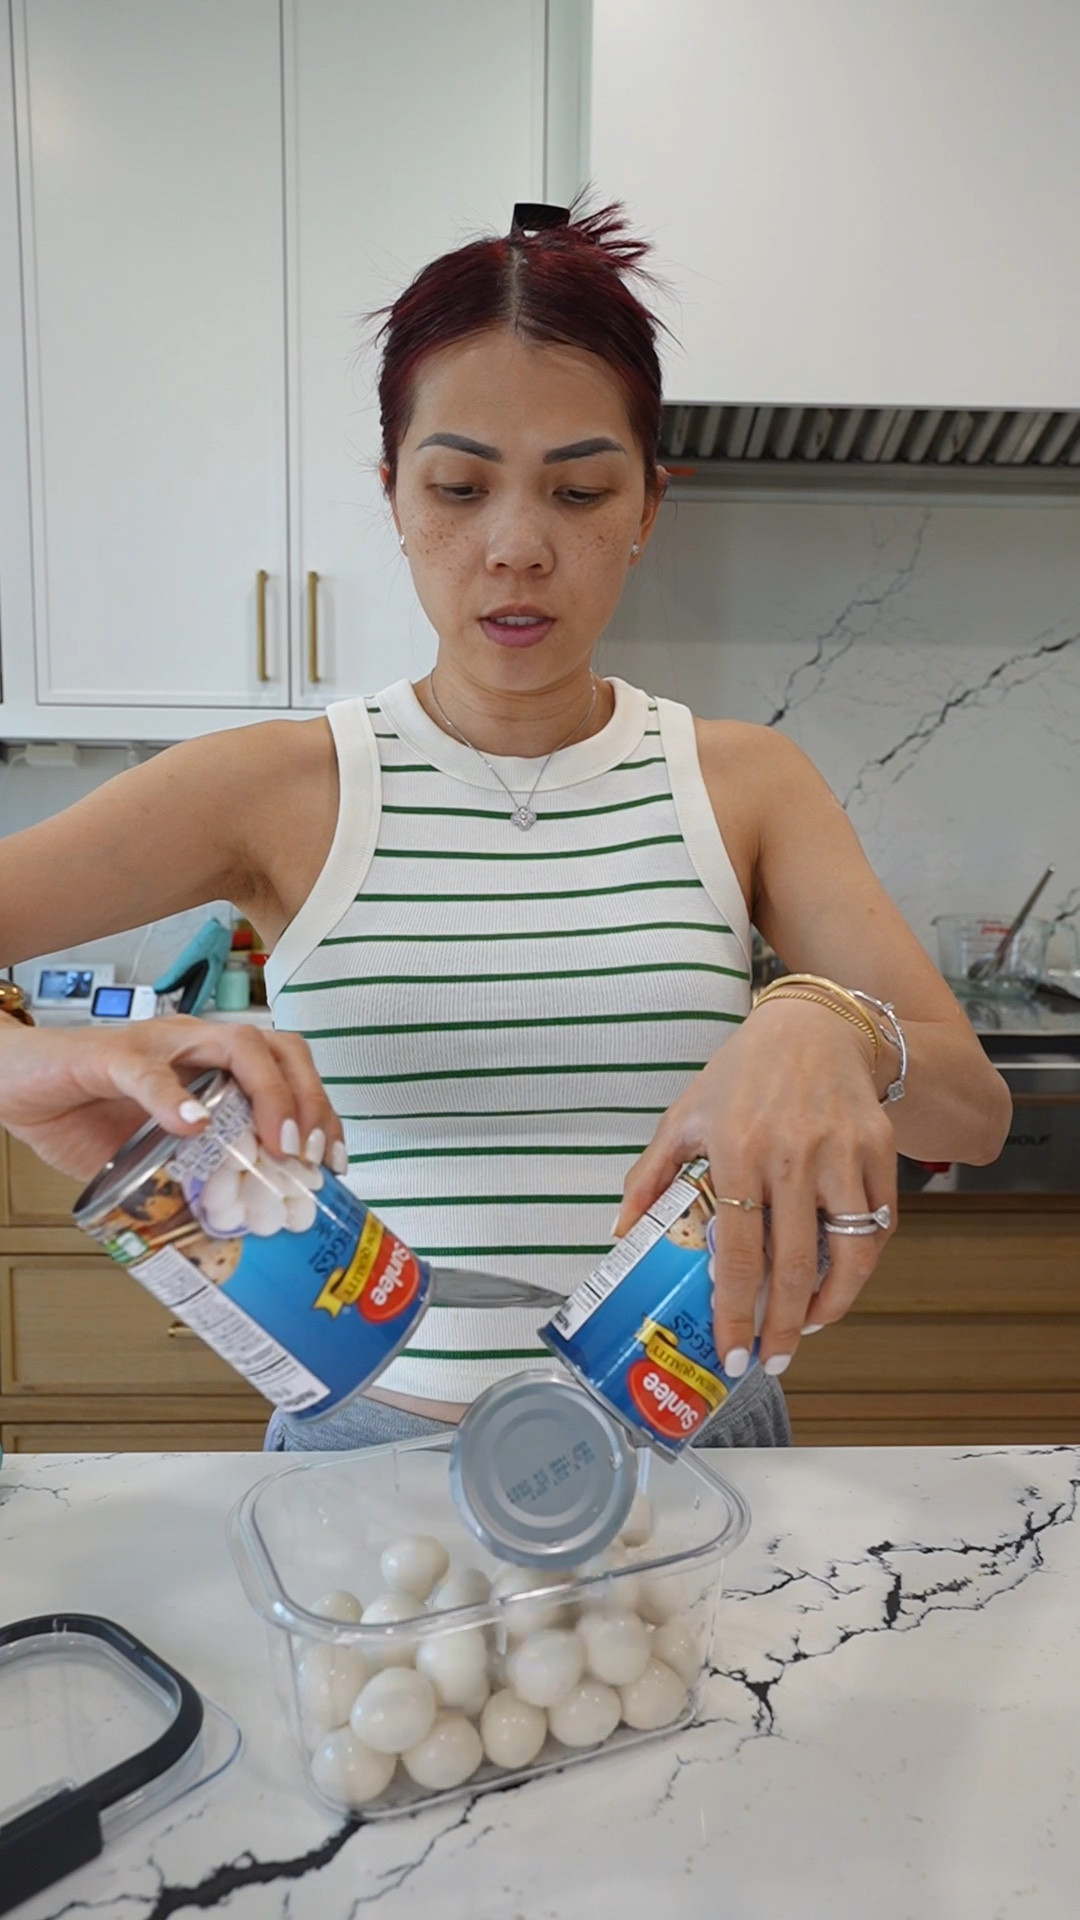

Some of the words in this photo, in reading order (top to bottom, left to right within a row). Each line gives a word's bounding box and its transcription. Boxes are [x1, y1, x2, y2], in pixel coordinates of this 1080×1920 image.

[370, 1241, 411, 1306] Sunlee
[653, 1345, 697, 1380] QUALITY
[671, 1314, 715, 1360] EGGS
[643, 1371, 699, 1431] Sunlee
